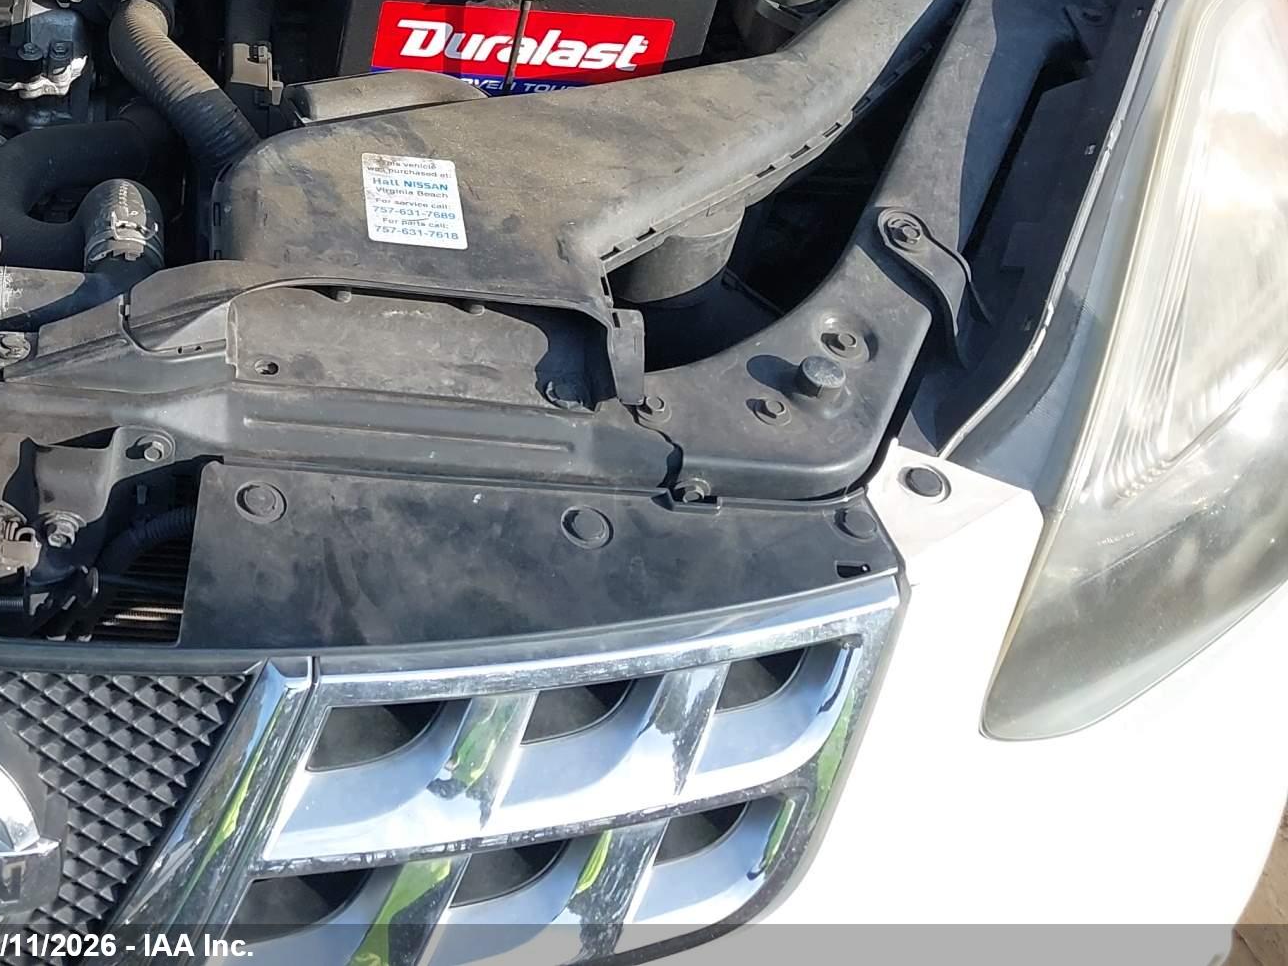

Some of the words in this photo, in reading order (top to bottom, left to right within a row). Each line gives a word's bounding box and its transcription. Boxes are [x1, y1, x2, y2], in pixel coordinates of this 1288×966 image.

[397, 19, 649, 71] Duralast
[388, 168, 438, 178] purchased
[372, 177, 400, 187] Hall
[403, 180, 449, 191] NISSAN
[376, 186, 414, 196] Virginia
[417, 190, 449, 199] Beach
[395, 200, 429, 208] service
